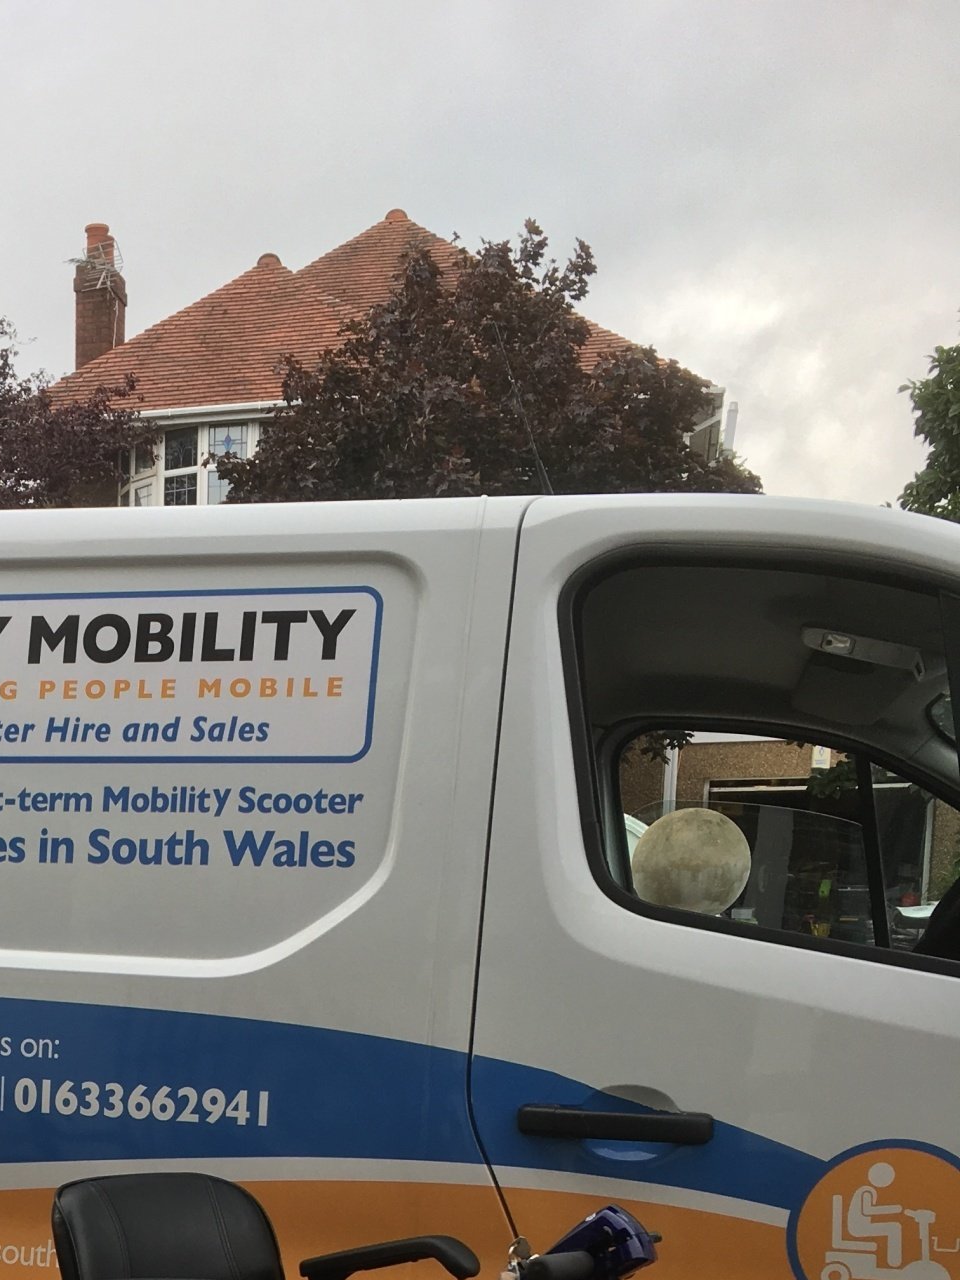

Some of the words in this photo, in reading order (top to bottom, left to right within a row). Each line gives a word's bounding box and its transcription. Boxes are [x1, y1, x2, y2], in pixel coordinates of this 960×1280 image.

[28, 608, 357, 663] MOBILITY
[39, 678, 178, 701] PEOPLE
[197, 676, 345, 698] MOBILE
[45, 715, 112, 744] Hire
[122, 715, 183, 744] and
[190, 715, 270, 744] Sales
[102, 785, 233, 817] Mobility
[238, 786, 365, 815] Scooter
[39, 827, 74, 865] in
[88, 827, 210, 867] South
[222, 829, 357, 868] Wales
[19, 1036, 60, 1060] on:
[14, 1076, 269, 1128] 01633662941
